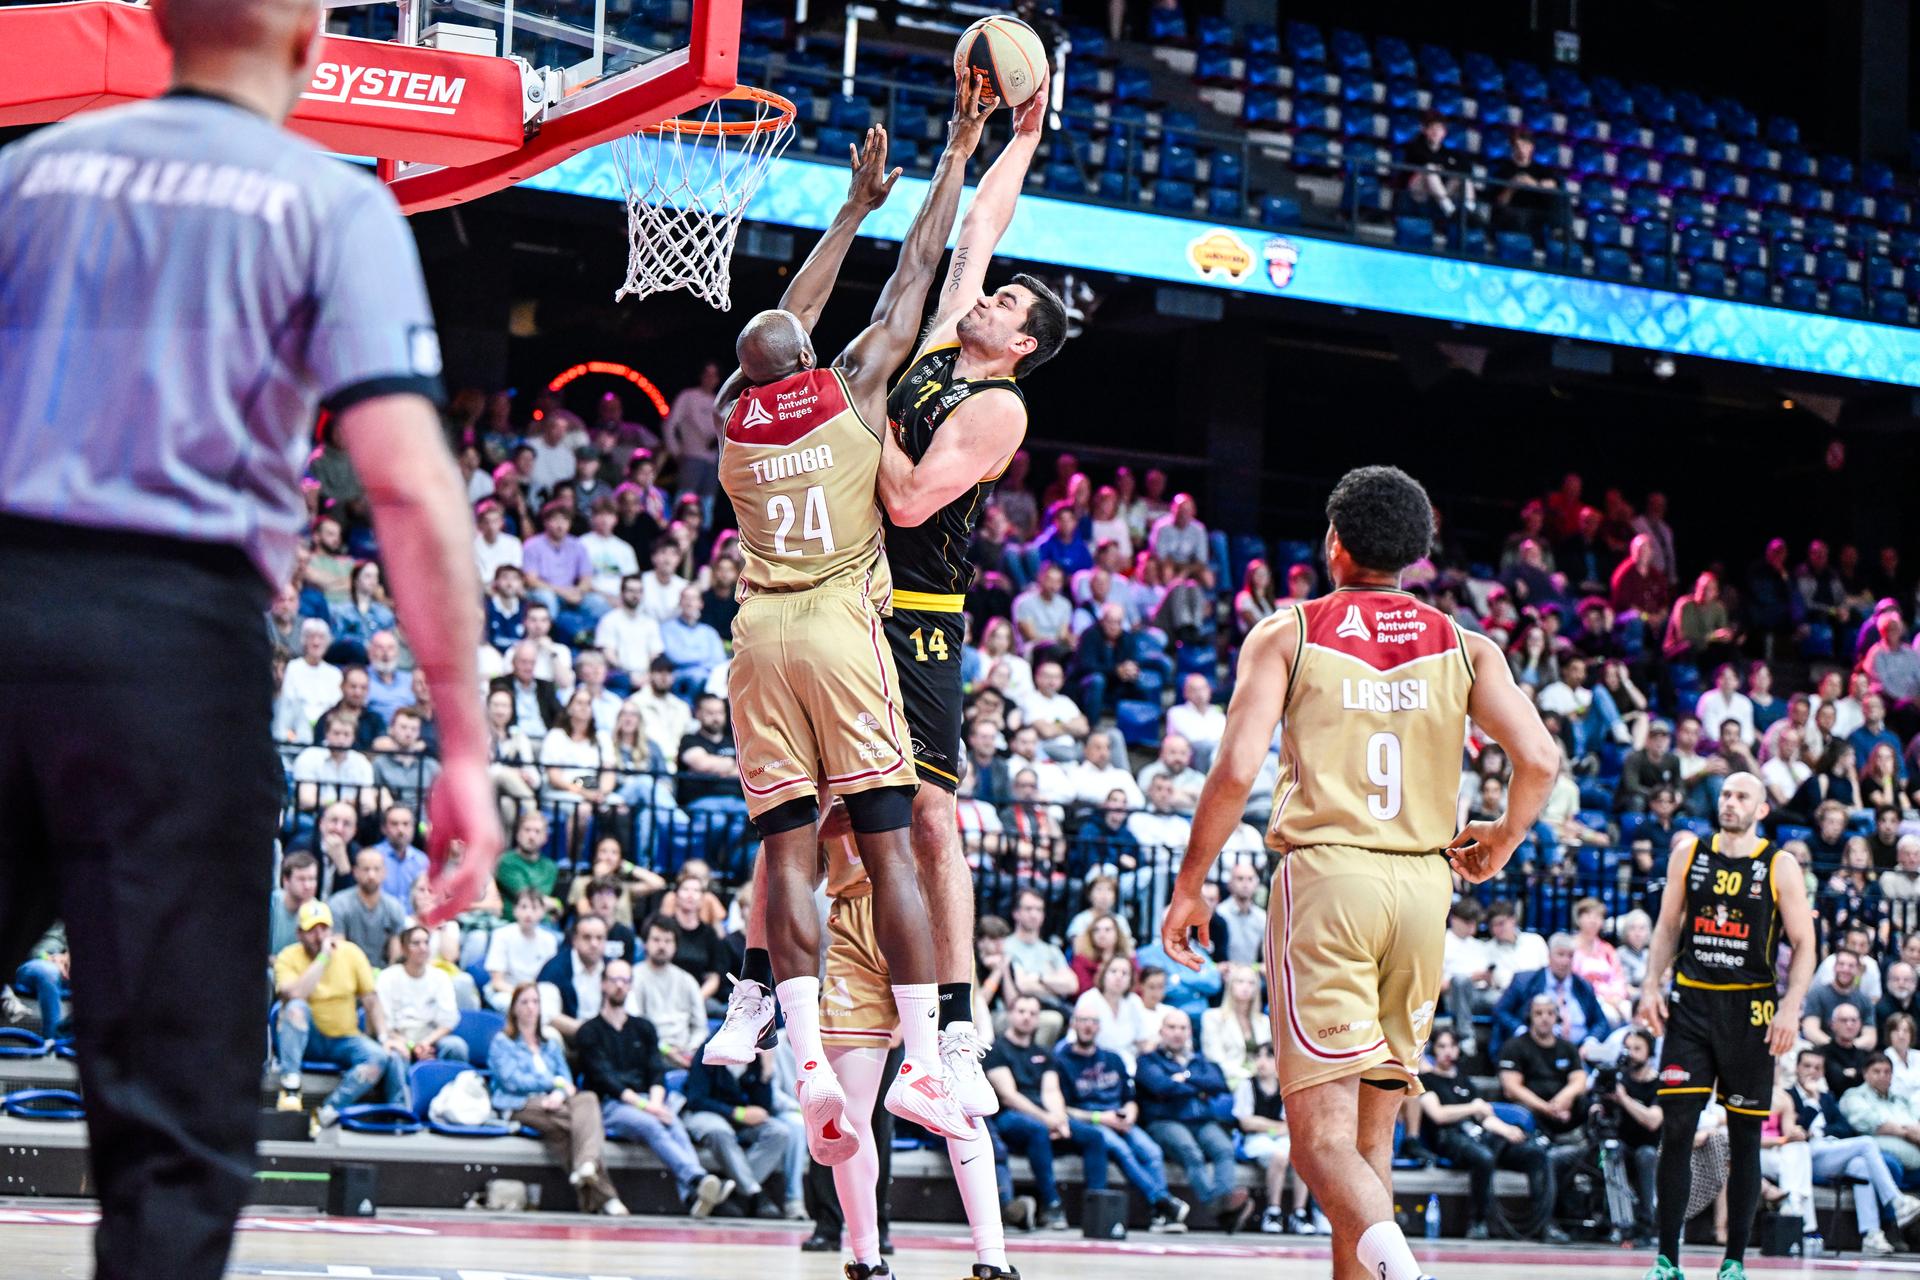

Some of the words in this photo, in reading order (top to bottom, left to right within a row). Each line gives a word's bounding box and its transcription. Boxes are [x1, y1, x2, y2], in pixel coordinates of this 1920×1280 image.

[311, 62, 467, 105] SYSTEM
[776, 391, 797, 402] Port
[798, 386, 809, 396] of
[777, 395, 819, 411] Antwerp
[779, 406, 812, 421] Bruges
[749, 444, 834, 486] TUMBA
[766, 485, 837, 557] 24
[1375, 609, 1402, 621] Port
[1404, 608, 1418, 619] of
[1376, 621, 1427, 634] Antwerp
[909, 626, 949, 662] 14
[1377, 632, 1418, 645] Bruges
[1342, 678, 1428, 713] LASISI
[1366, 731, 1402, 821] 9
[1712, 869, 1743, 896] 30
[1750, 1000, 1775, 1026] 30
